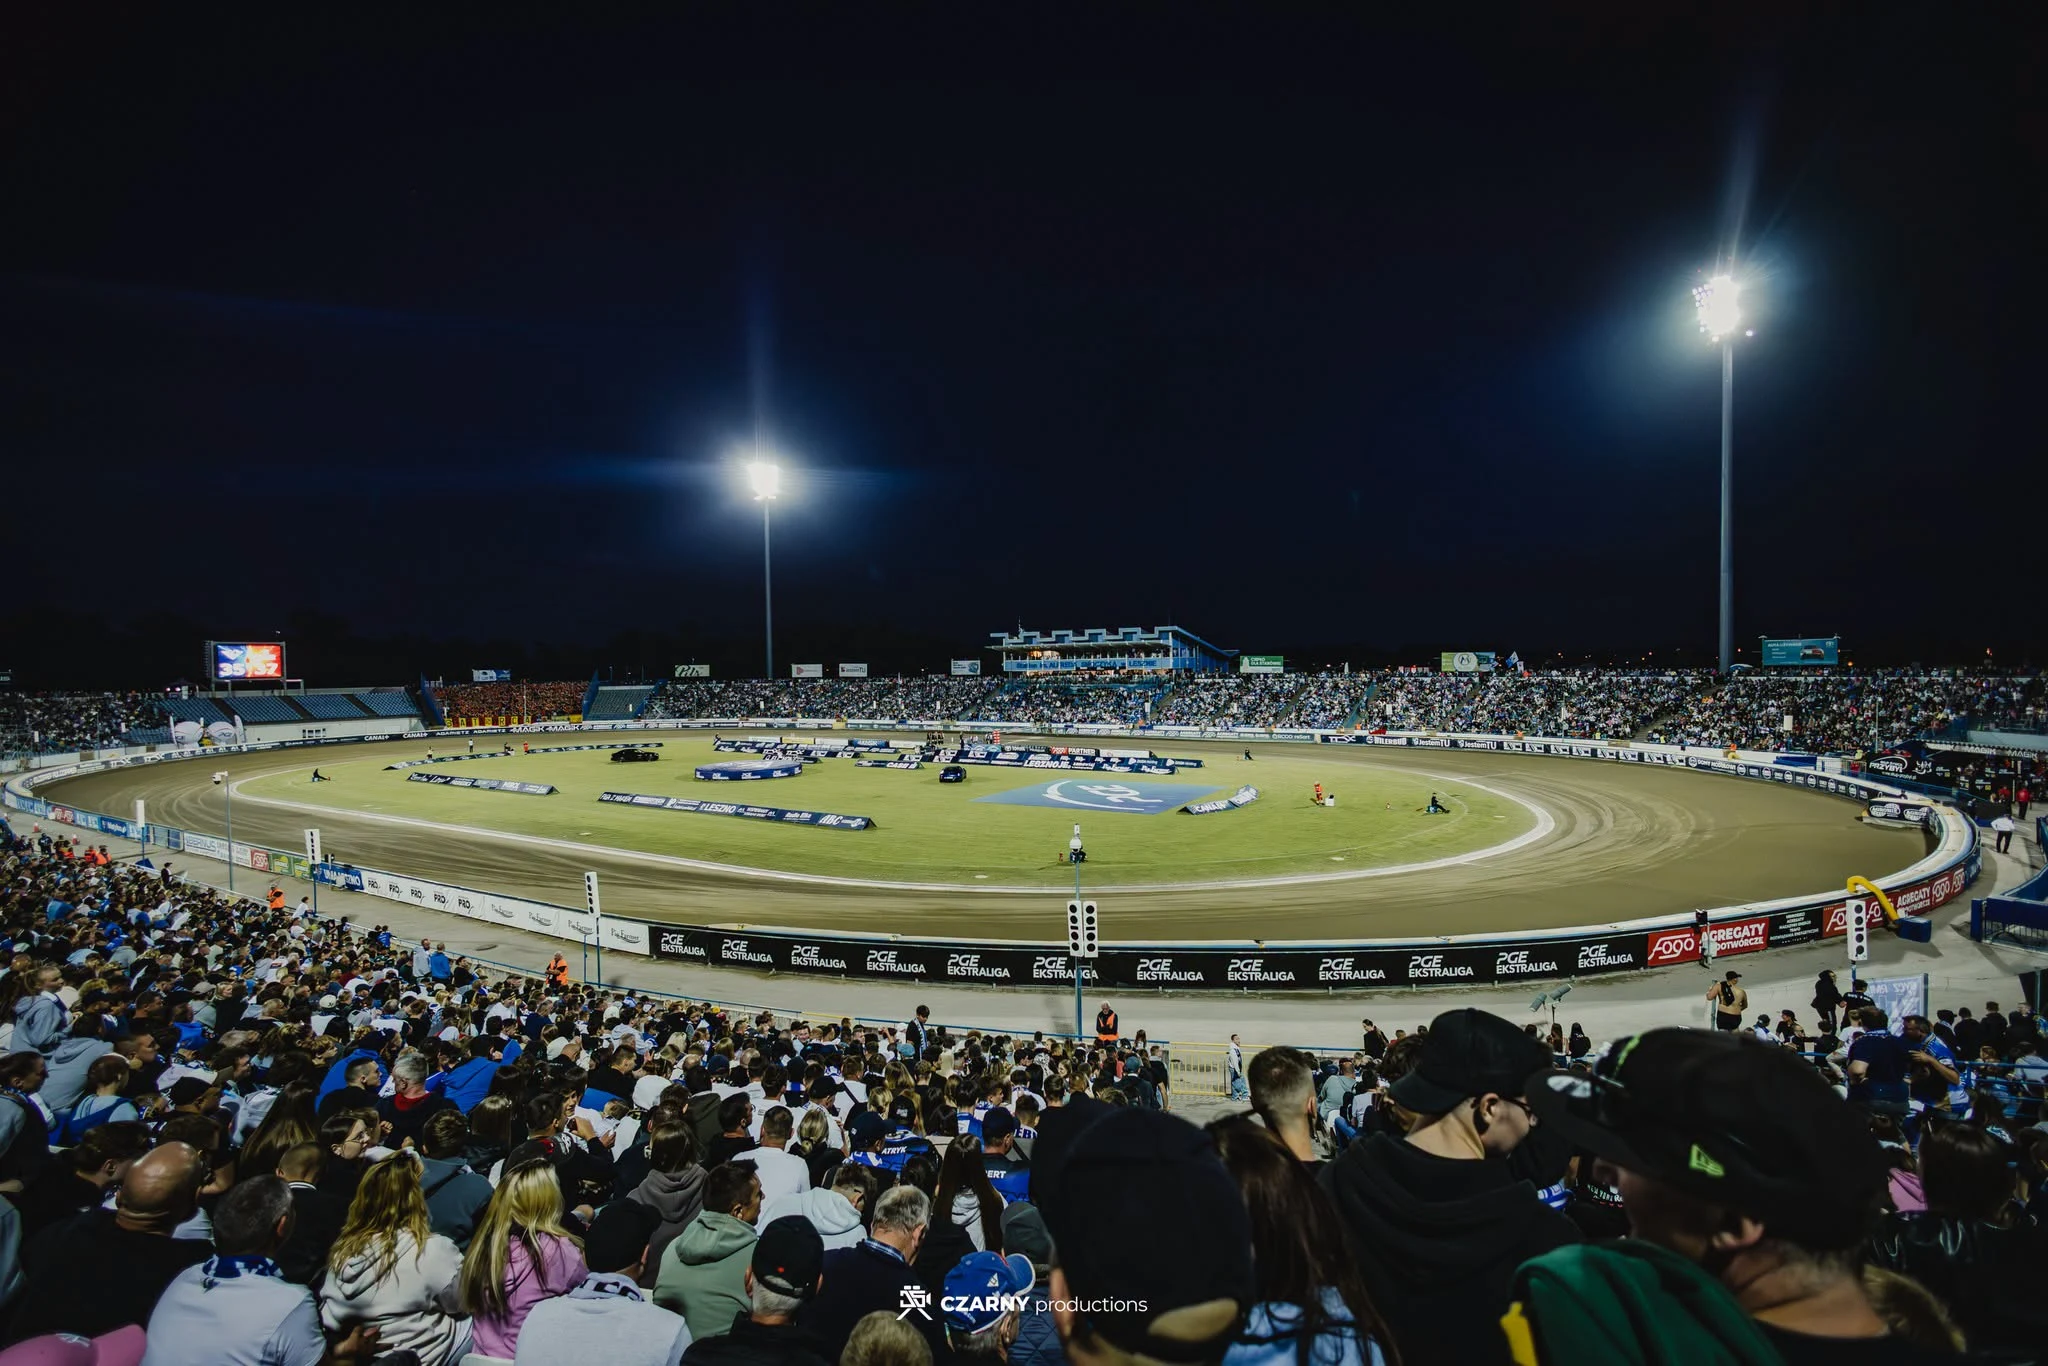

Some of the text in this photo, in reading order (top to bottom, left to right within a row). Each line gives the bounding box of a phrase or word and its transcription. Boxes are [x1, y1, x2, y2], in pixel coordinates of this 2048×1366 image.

[219, 663, 246, 676] 35
[705, 803, 737, 814] LESZNO
[818, 814, 843, 826] ABC
[661, 933, 684, 945] PGE
[1699, 923, 1766, 944] AGREGATY
[661, 943, 706, 956] EKSTRALIGA
[722, 939, 748, 952] PGE
[791, 945, 820, 958] PGE
[1578, 944, 1608, 958] PGE
[722, 950, 773, 963] EKSTRALIGA
[867, 950, 898, 962] PGE
[948, 954, 980, 967] PGE
[1409, 955, 1443, 968] PGE
[1497, 951, 1529, 964] PGE
[1578, 954, 1633, 968] EKSTRALIGA
[791, 956, 847, 969] EKSTRALIGA
[867, 962, 926, 973] EKSTRALIGA
[1033, 957, 1067, 969] PGE
[1137, 959, 1173, 971] PGE
[1228, 959, 1264, 971] PGE
[1319, 958, 1355, 971] PGE
[1496, 962, 1558, 974] EKSTRALIGA
[947, 966, 1010, 977] EKSTRALIGA
[1033, 969, 1099, 979] EKSTRAGA
[1137, 971, 1204, 981] EKSTRALIGA
[1228, 971, 1295, 981] EKSTRALIGA
[1319, 969, 1385, 980] EKSTRALIGA
[1409, 967, 1473, 978] EKSTRALIGA
[881, 1146, 907, 1155] ATRYK
